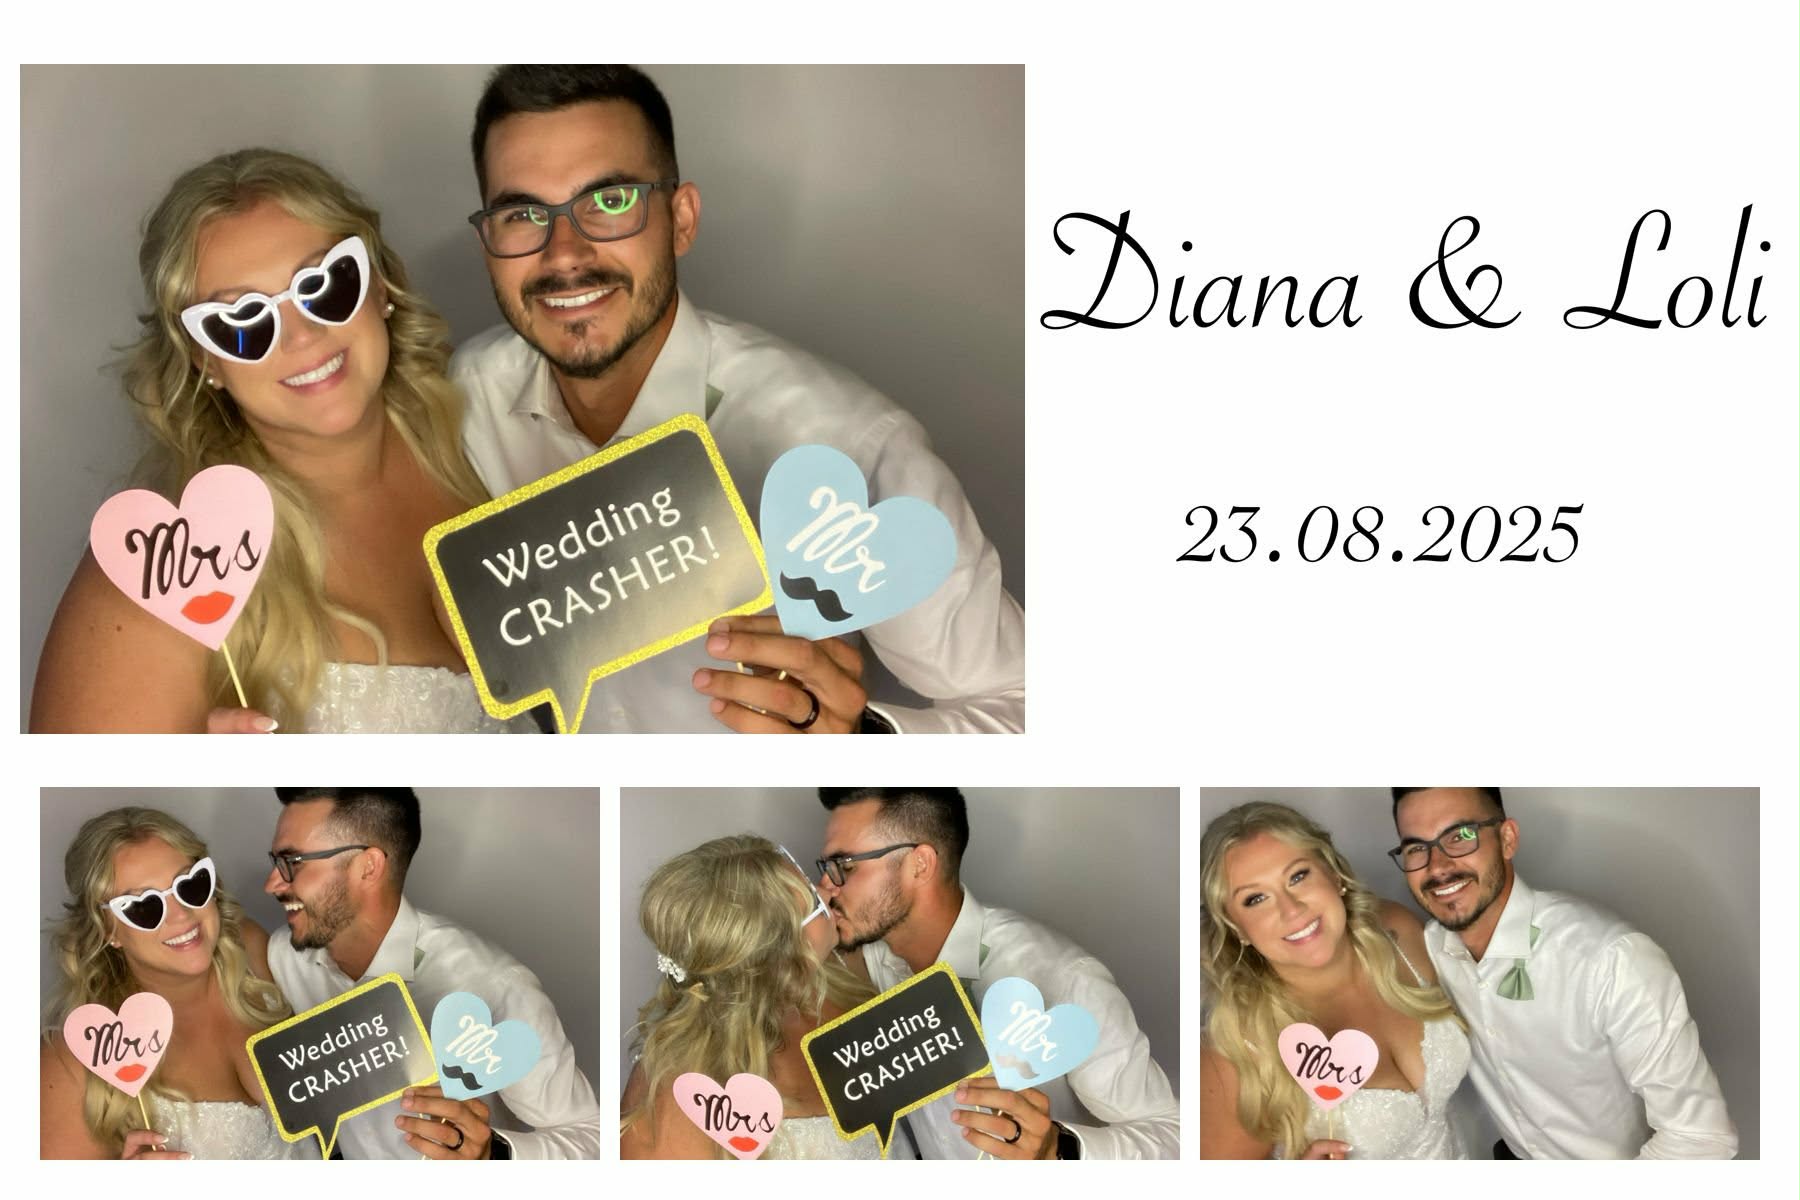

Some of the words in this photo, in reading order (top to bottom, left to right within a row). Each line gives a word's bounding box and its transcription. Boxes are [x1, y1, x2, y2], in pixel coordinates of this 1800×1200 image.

[124, 516, 262, 600] Mrs
[481, 486, 682, 588] Wedding
[785, 485, 887, 593] Mr
[498, 525, 722, 646] CRASHER!
[84, 1020, 165, 1067] Mrs
[277, 1013, 389, 1071] Wedding
[445, 1014, 503, 1075] Mr
[832, 1004, 942, 1069] Wedding
[843, 1026, 965, 1101] CRASHER!
[997, 1000, 1058, 1063] Mr
[1295, 1041, 1366, 1085] Mrs
[287, 1035, 411, 1103] CRASHER!
[693, 1093, 776, 1133] Mrs
